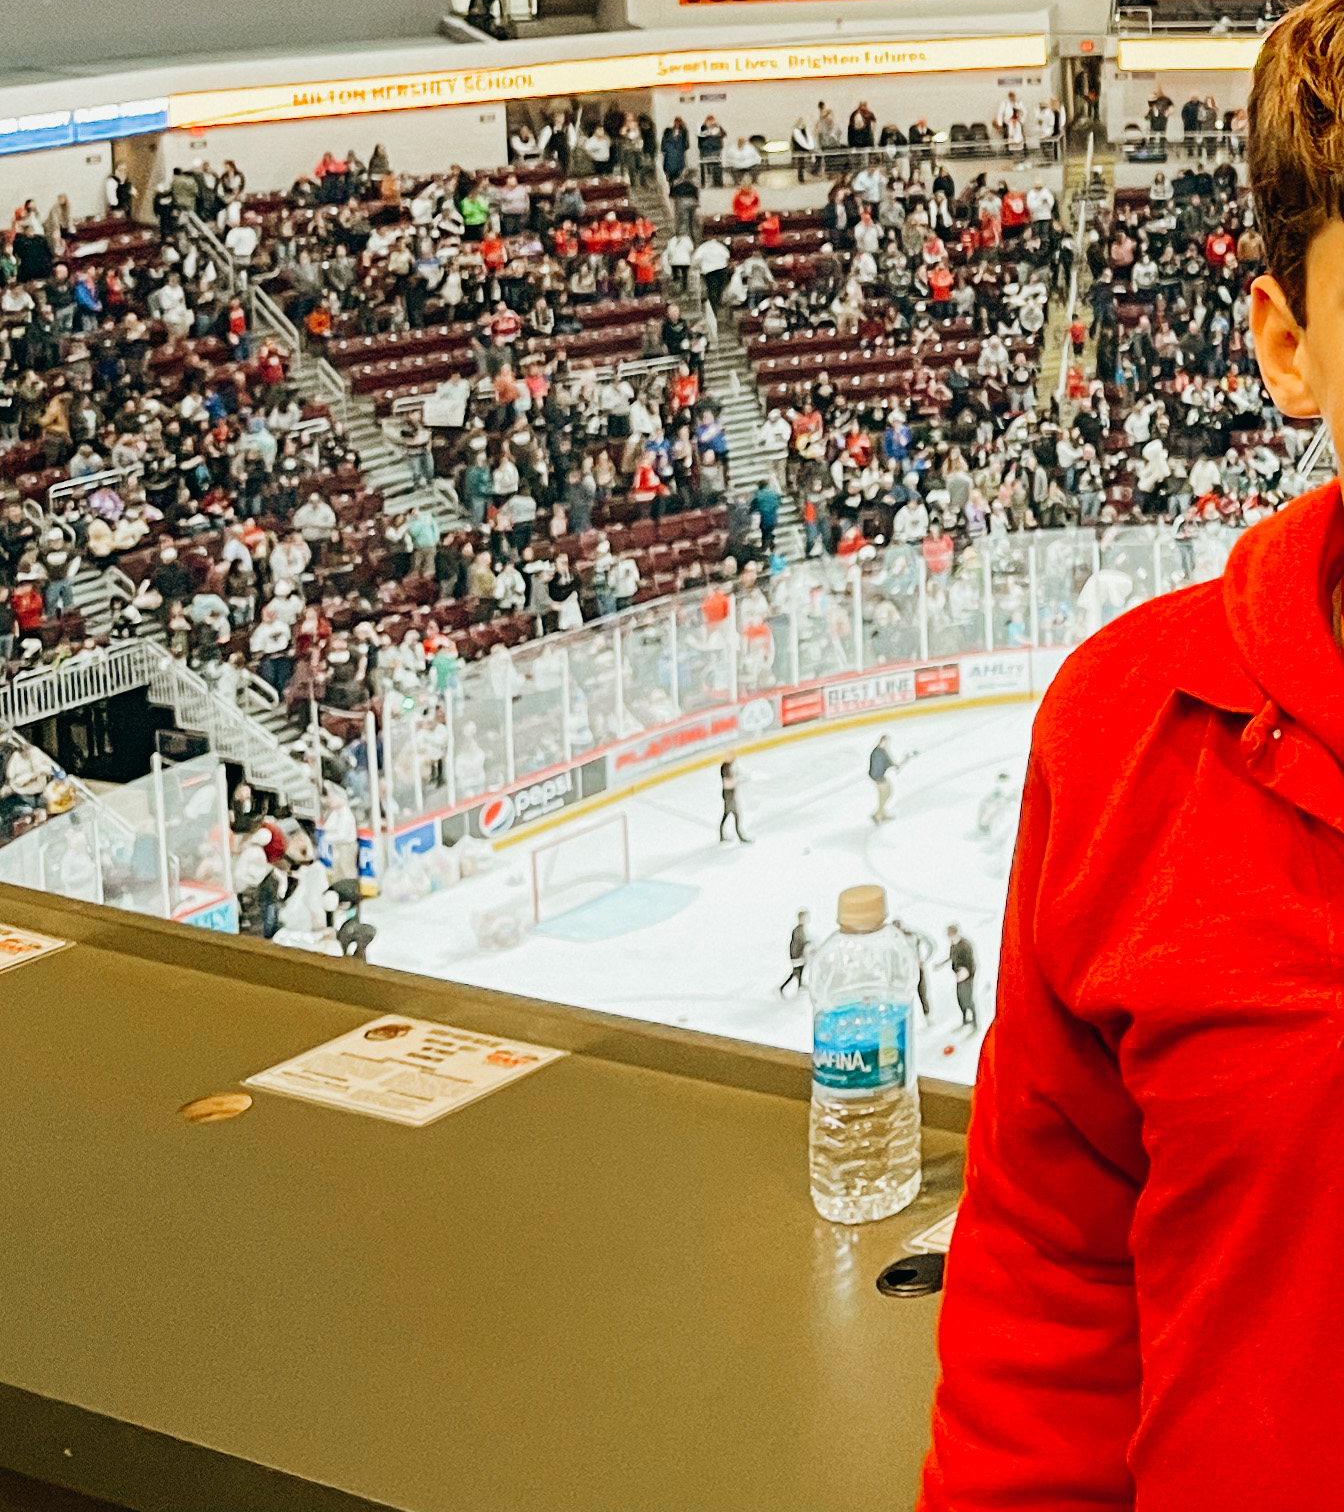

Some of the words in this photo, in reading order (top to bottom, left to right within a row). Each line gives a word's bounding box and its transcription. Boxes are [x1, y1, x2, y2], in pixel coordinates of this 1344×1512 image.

[293, 90, 366, 106] MILTON
[464, 74, 535, 94] SCHOOL
[514, 771, 572, 816] pepsi
